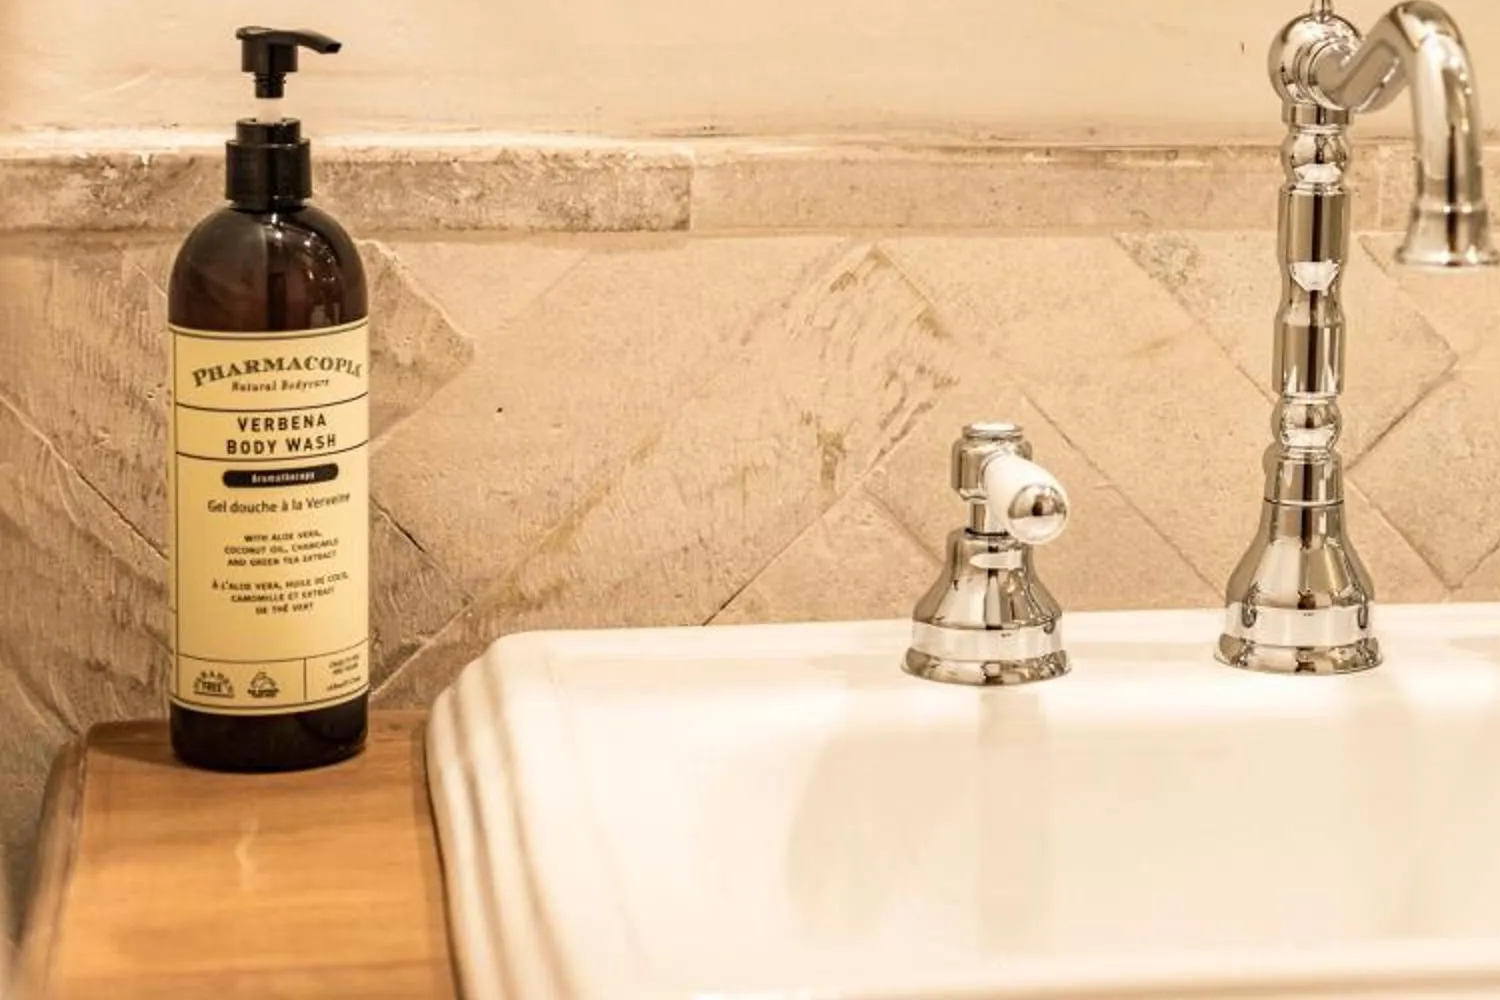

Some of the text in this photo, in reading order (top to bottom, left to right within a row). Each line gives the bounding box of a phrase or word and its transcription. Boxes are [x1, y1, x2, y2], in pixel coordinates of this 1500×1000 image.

[237, 413, 327, 433] VERBENA
[226, 433, 337, 455] BODY WASH
[207, 499, 227, 513] Gel
[229, 500, 278, 514] douche
[292, 498, 303, 511] la
